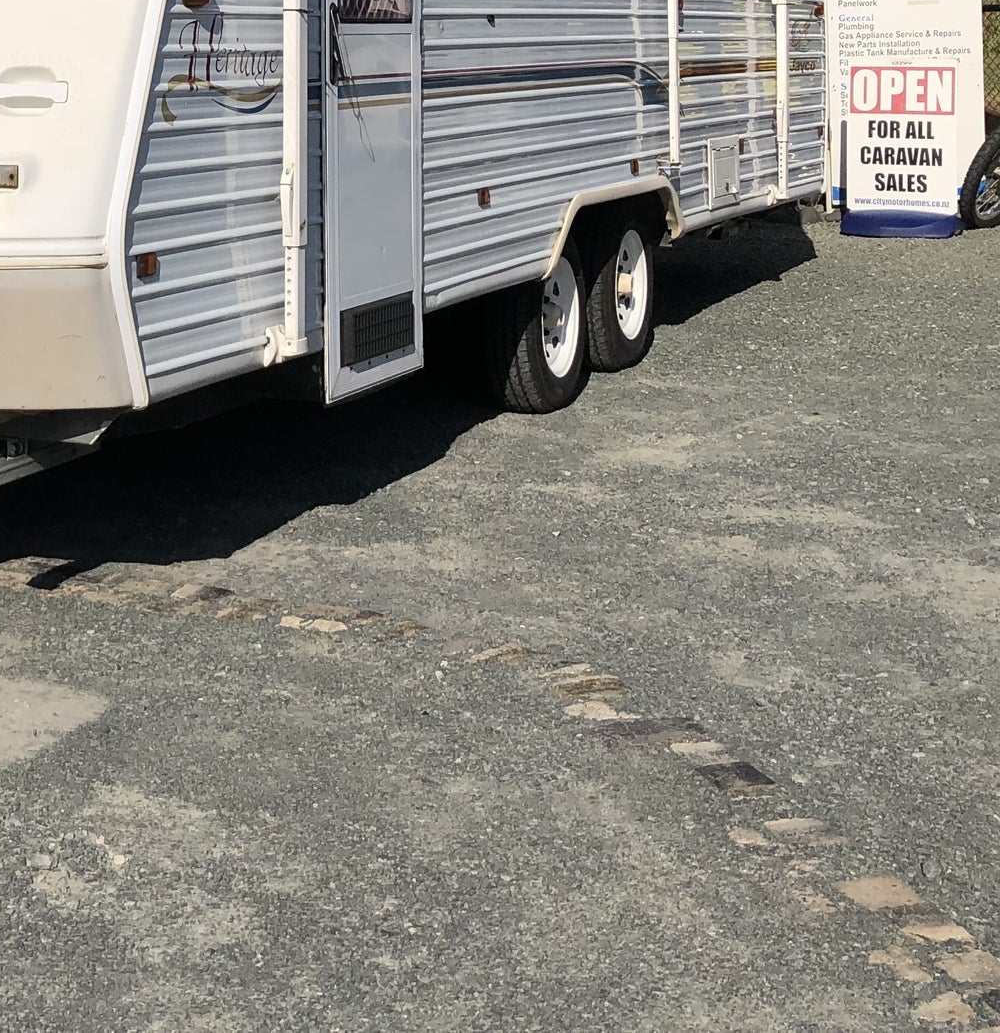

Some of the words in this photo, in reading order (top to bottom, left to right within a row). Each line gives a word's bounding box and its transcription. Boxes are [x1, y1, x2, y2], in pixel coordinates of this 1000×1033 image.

[838, 0, 878, 8] Panelwork
[838, 14, 874, 22] General
[838, 22, 875, 32] Plumbing
[839, 31, 854, 40] Gas
[855, 31, 894, 41] Appliance
[895, 29, 924, 39] Service
[925, 29, 931, 38] &
[933, 29, 962, 39] Repairs
[839, 41, 856, 49] New
[857, 40, 877, 48] Parts
[879, 39, 921, 48] Installation
[178, 12, 281, 91] Heritage
[839, 49, 865, 57] Plastic
[866, 48, 885, 57] Tank
[887, 46, 933, 56] Manufacture
[935, 46, 941, 55] &
[943, 46, 972, 56] Repairs
[852, 68, 953, 113] OPEN
[868, 120, 901, 139] FOR
[905, 121, 935, 140] ALL
[860, 146, 943, 167] CARAVAN
[874, 173, 928, 194] SALES
[854, 197, 950, 209] www.citymotorhomes.co.nz
